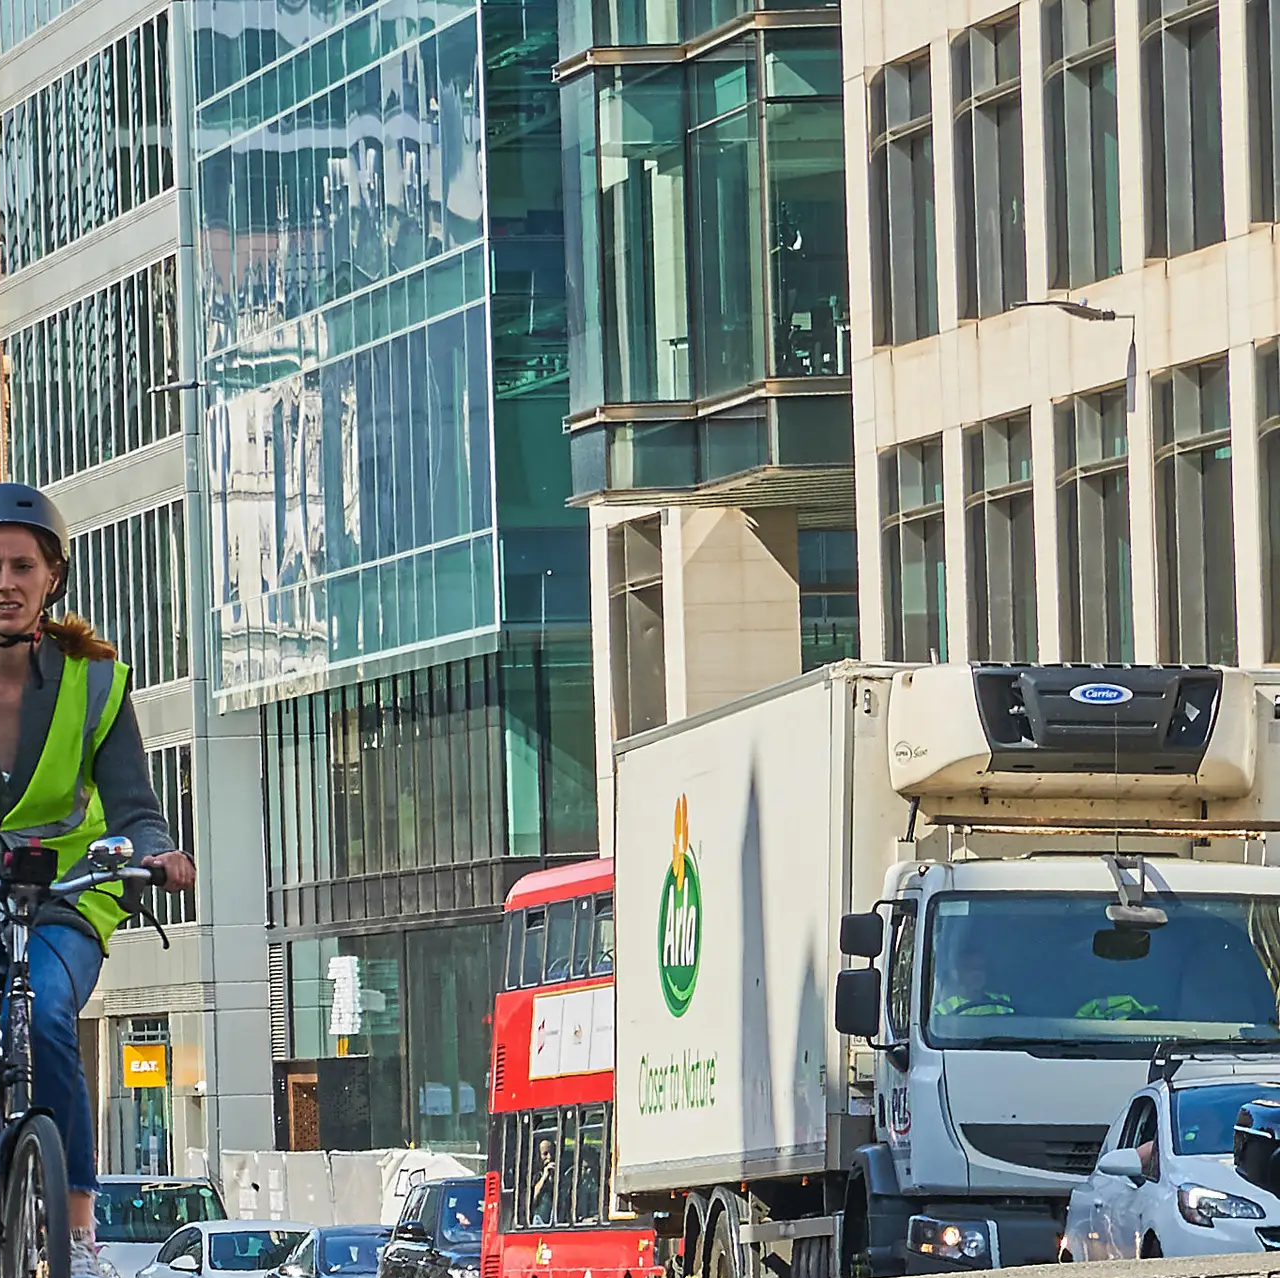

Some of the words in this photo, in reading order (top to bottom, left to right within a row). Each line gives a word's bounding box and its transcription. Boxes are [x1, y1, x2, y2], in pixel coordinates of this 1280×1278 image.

[1085, 689, 1119, 698] Carrier
[663, 877, 697, 967] Arla
[638, 1053, 668, 1116] Closer
[670, 1054, 680, 1112] to
[682, 1048, 716, 1110] Nature
